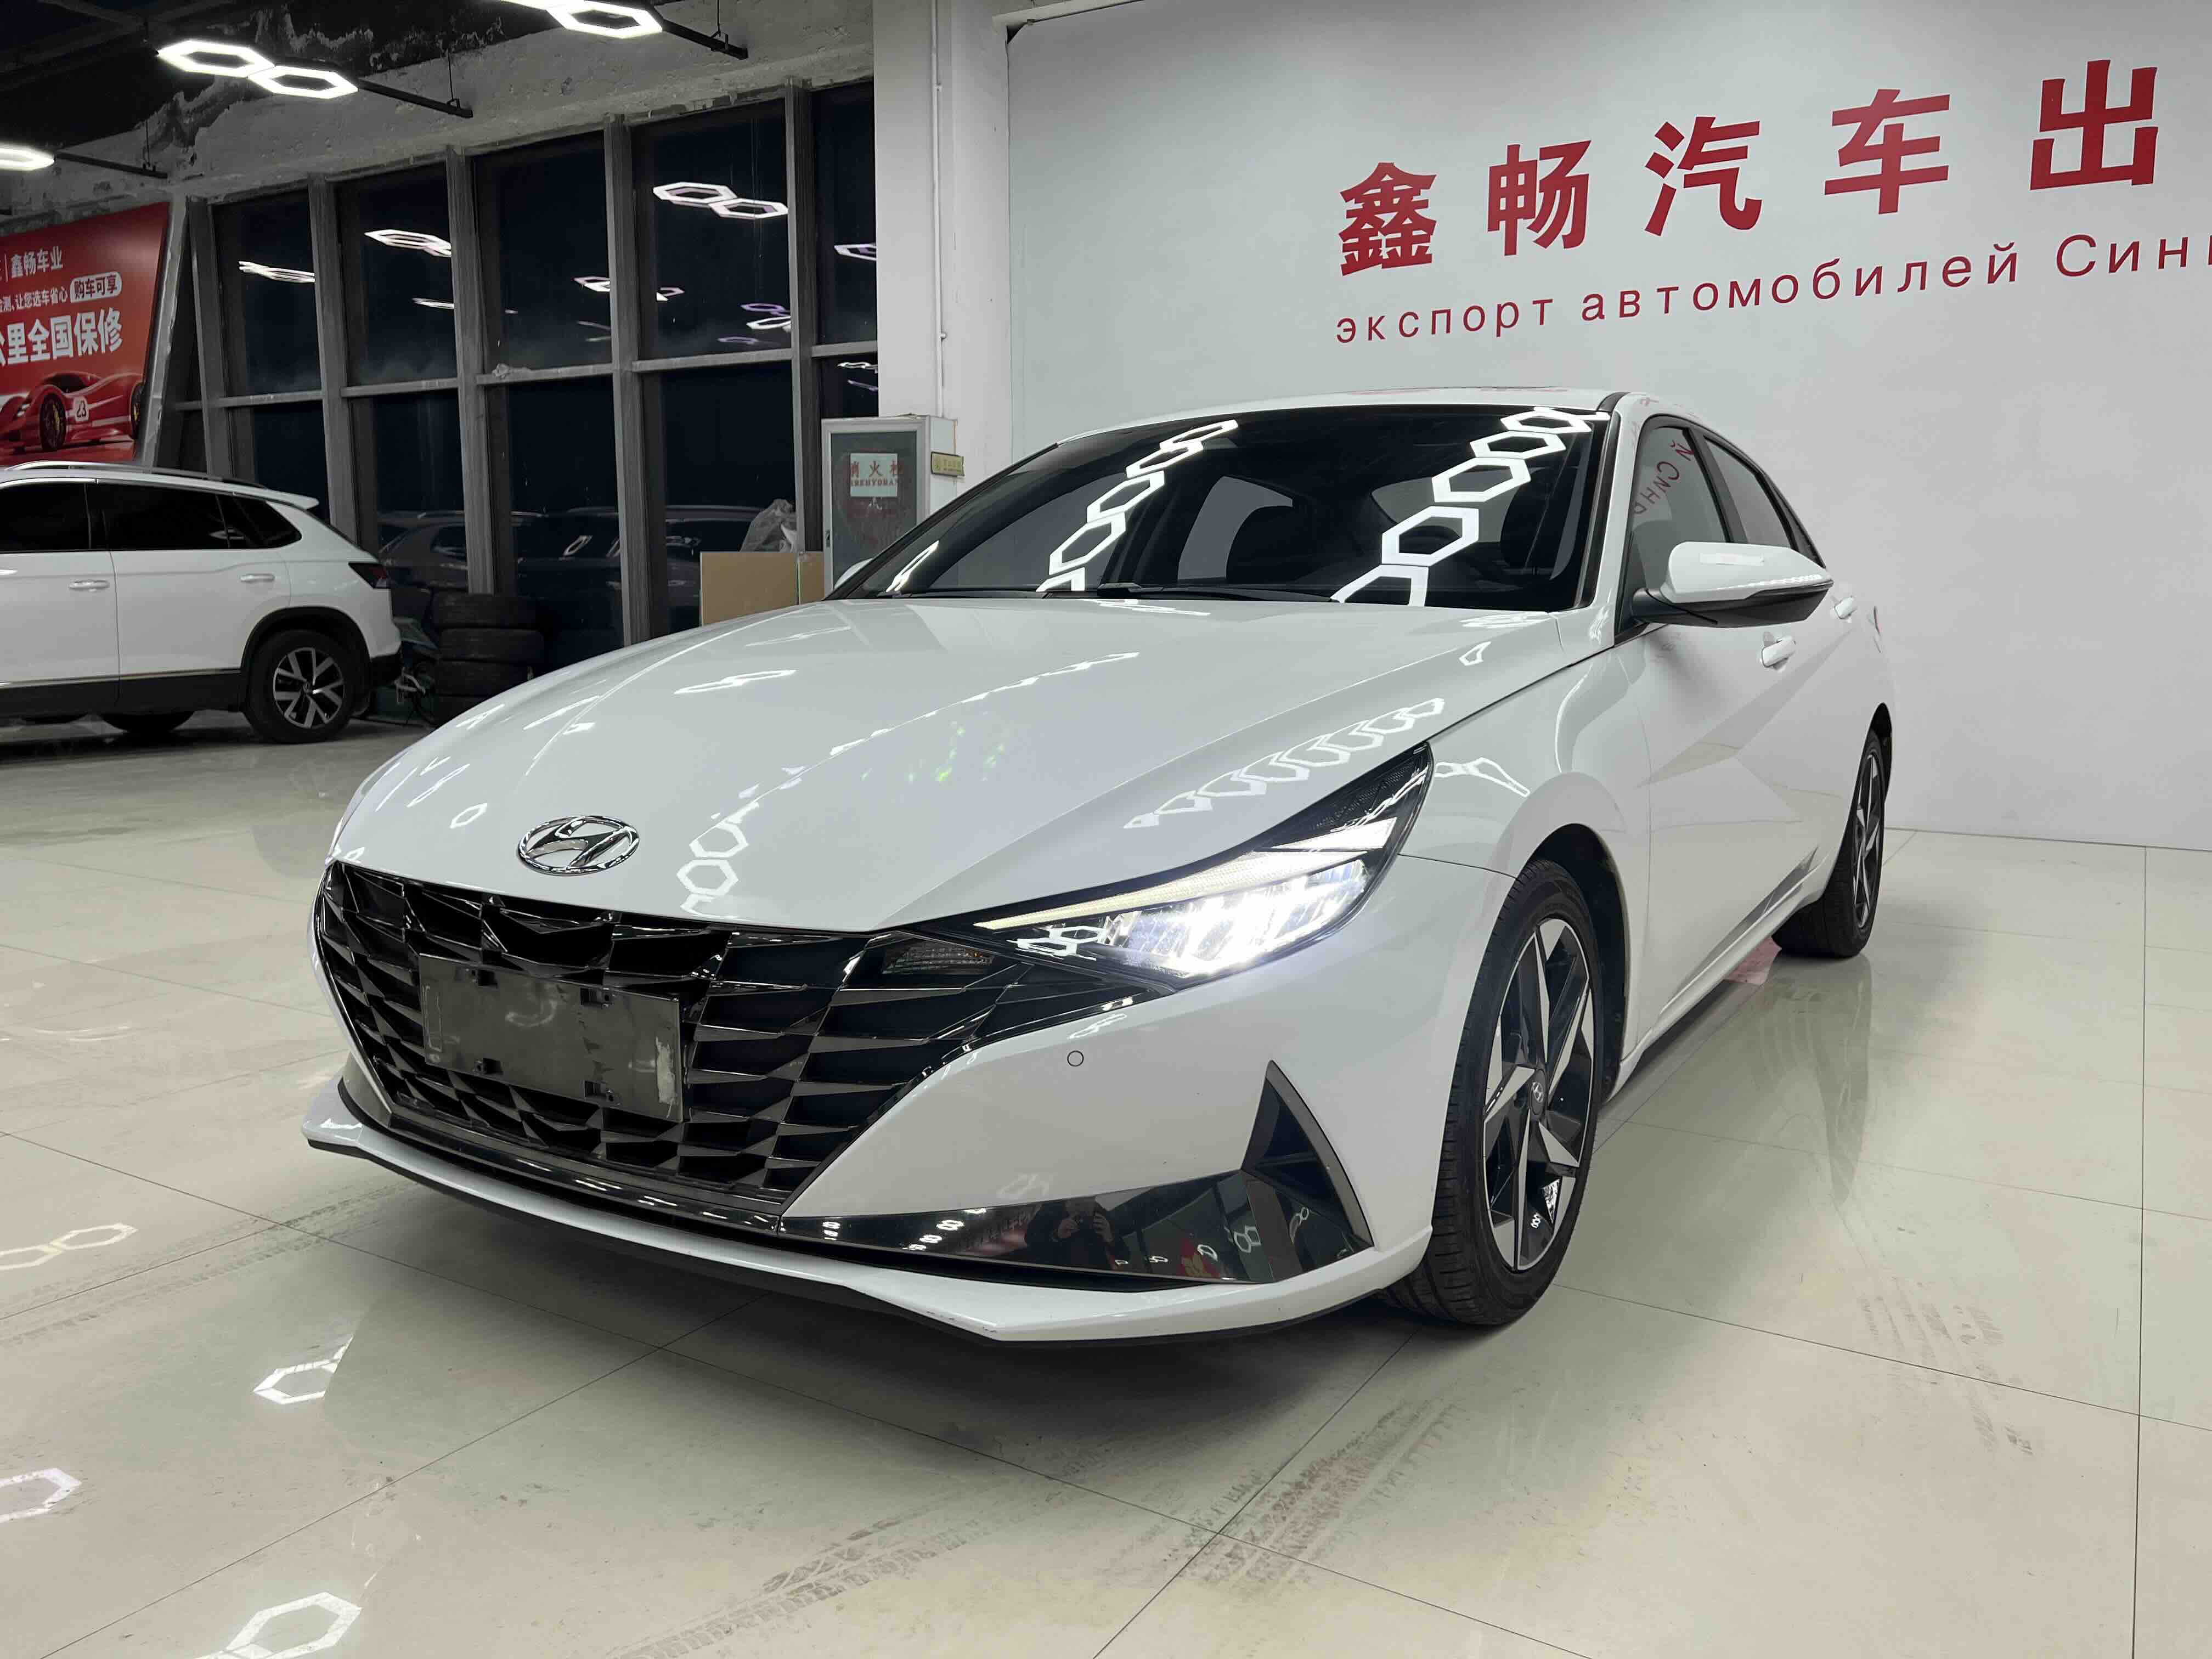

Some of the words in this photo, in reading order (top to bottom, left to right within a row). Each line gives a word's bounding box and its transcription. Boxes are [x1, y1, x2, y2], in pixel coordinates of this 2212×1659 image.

[1339, 59, 2158, 276] 鑫畅汽车出
[11, 246, 63, 279] 鑫畅车业
[74, 275, 117, 300] 购车可享
[1336, 298, 1554, 343] экспорт
[1582, 242, 2018, 321] автомобилей
[2056, 234, 2212, 277] Син
[0, 307, 123, 366] 里全国保修
